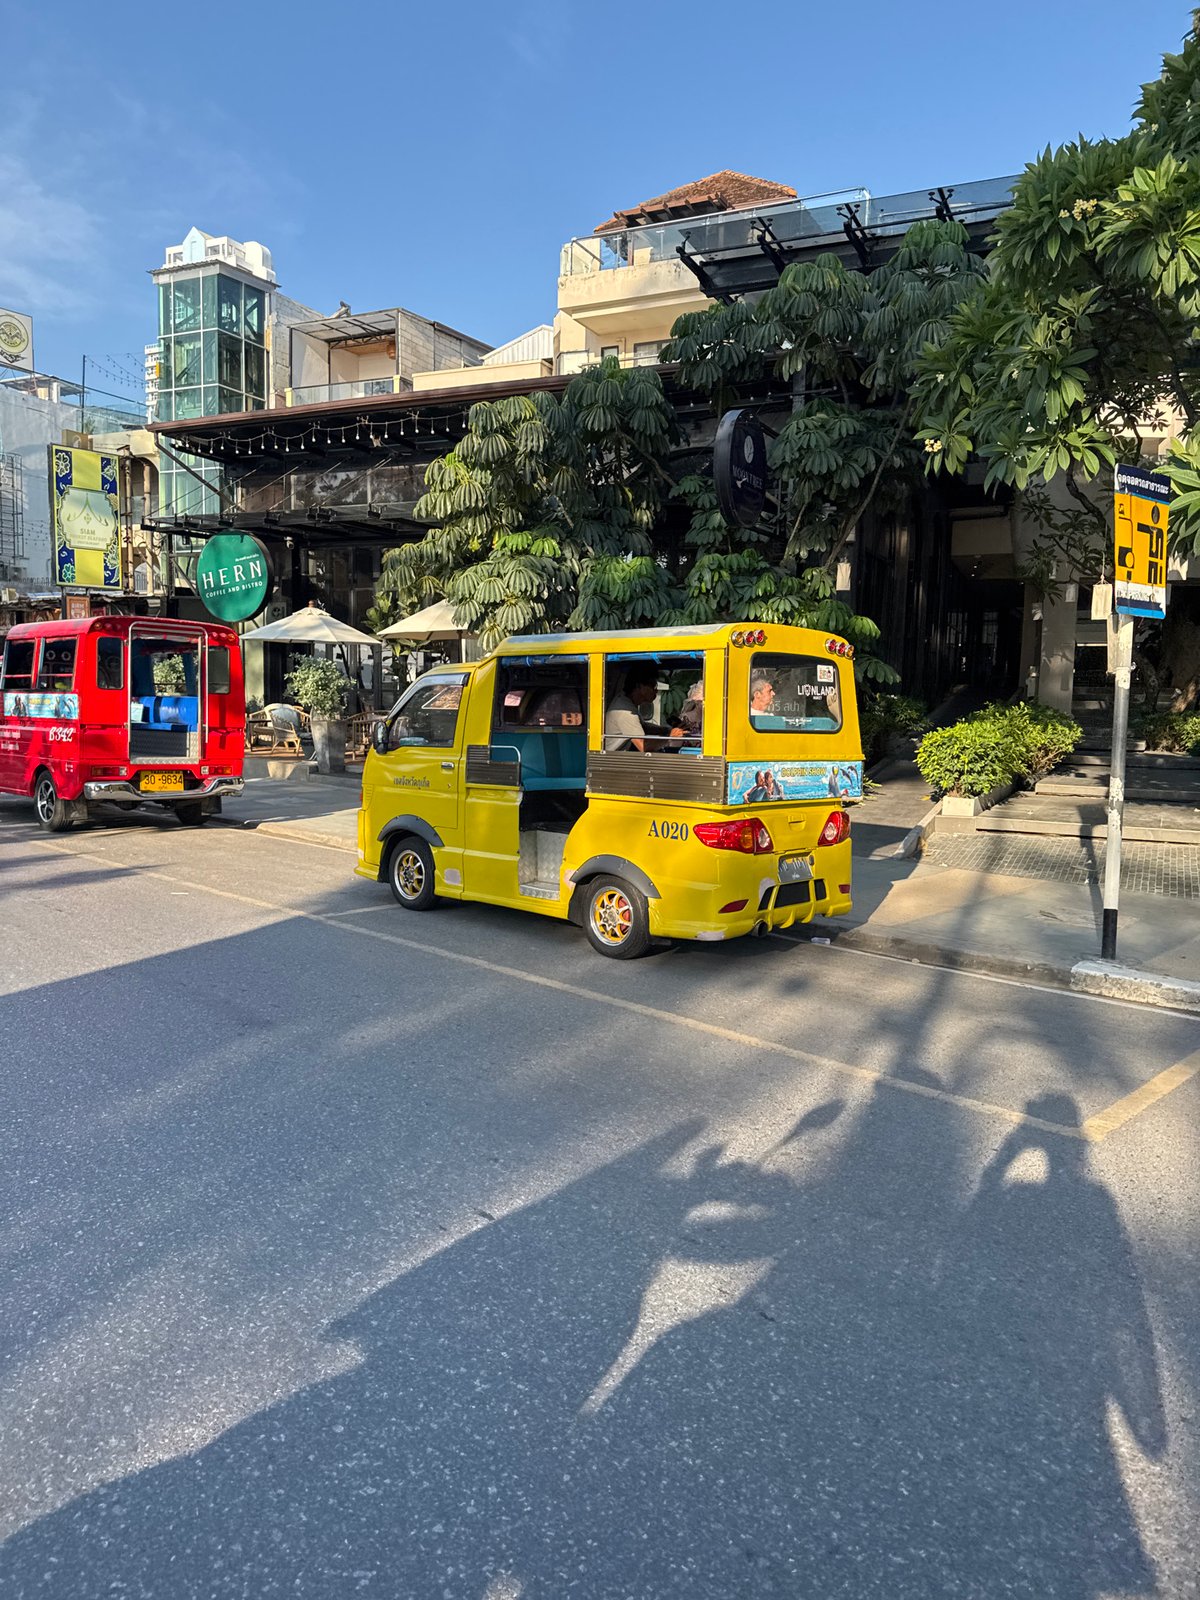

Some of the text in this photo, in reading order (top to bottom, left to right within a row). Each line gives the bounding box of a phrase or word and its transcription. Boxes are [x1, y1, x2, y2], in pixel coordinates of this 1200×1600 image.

[202, 560, 262, 589] HERN
[205, 580, 263, 599] COFFEE AND BISTRO
[48, 726, 74, 742] B342
[781, 766, 827, 777] DOLPHIN SHOW
[647, 819, 689, 841] A020
